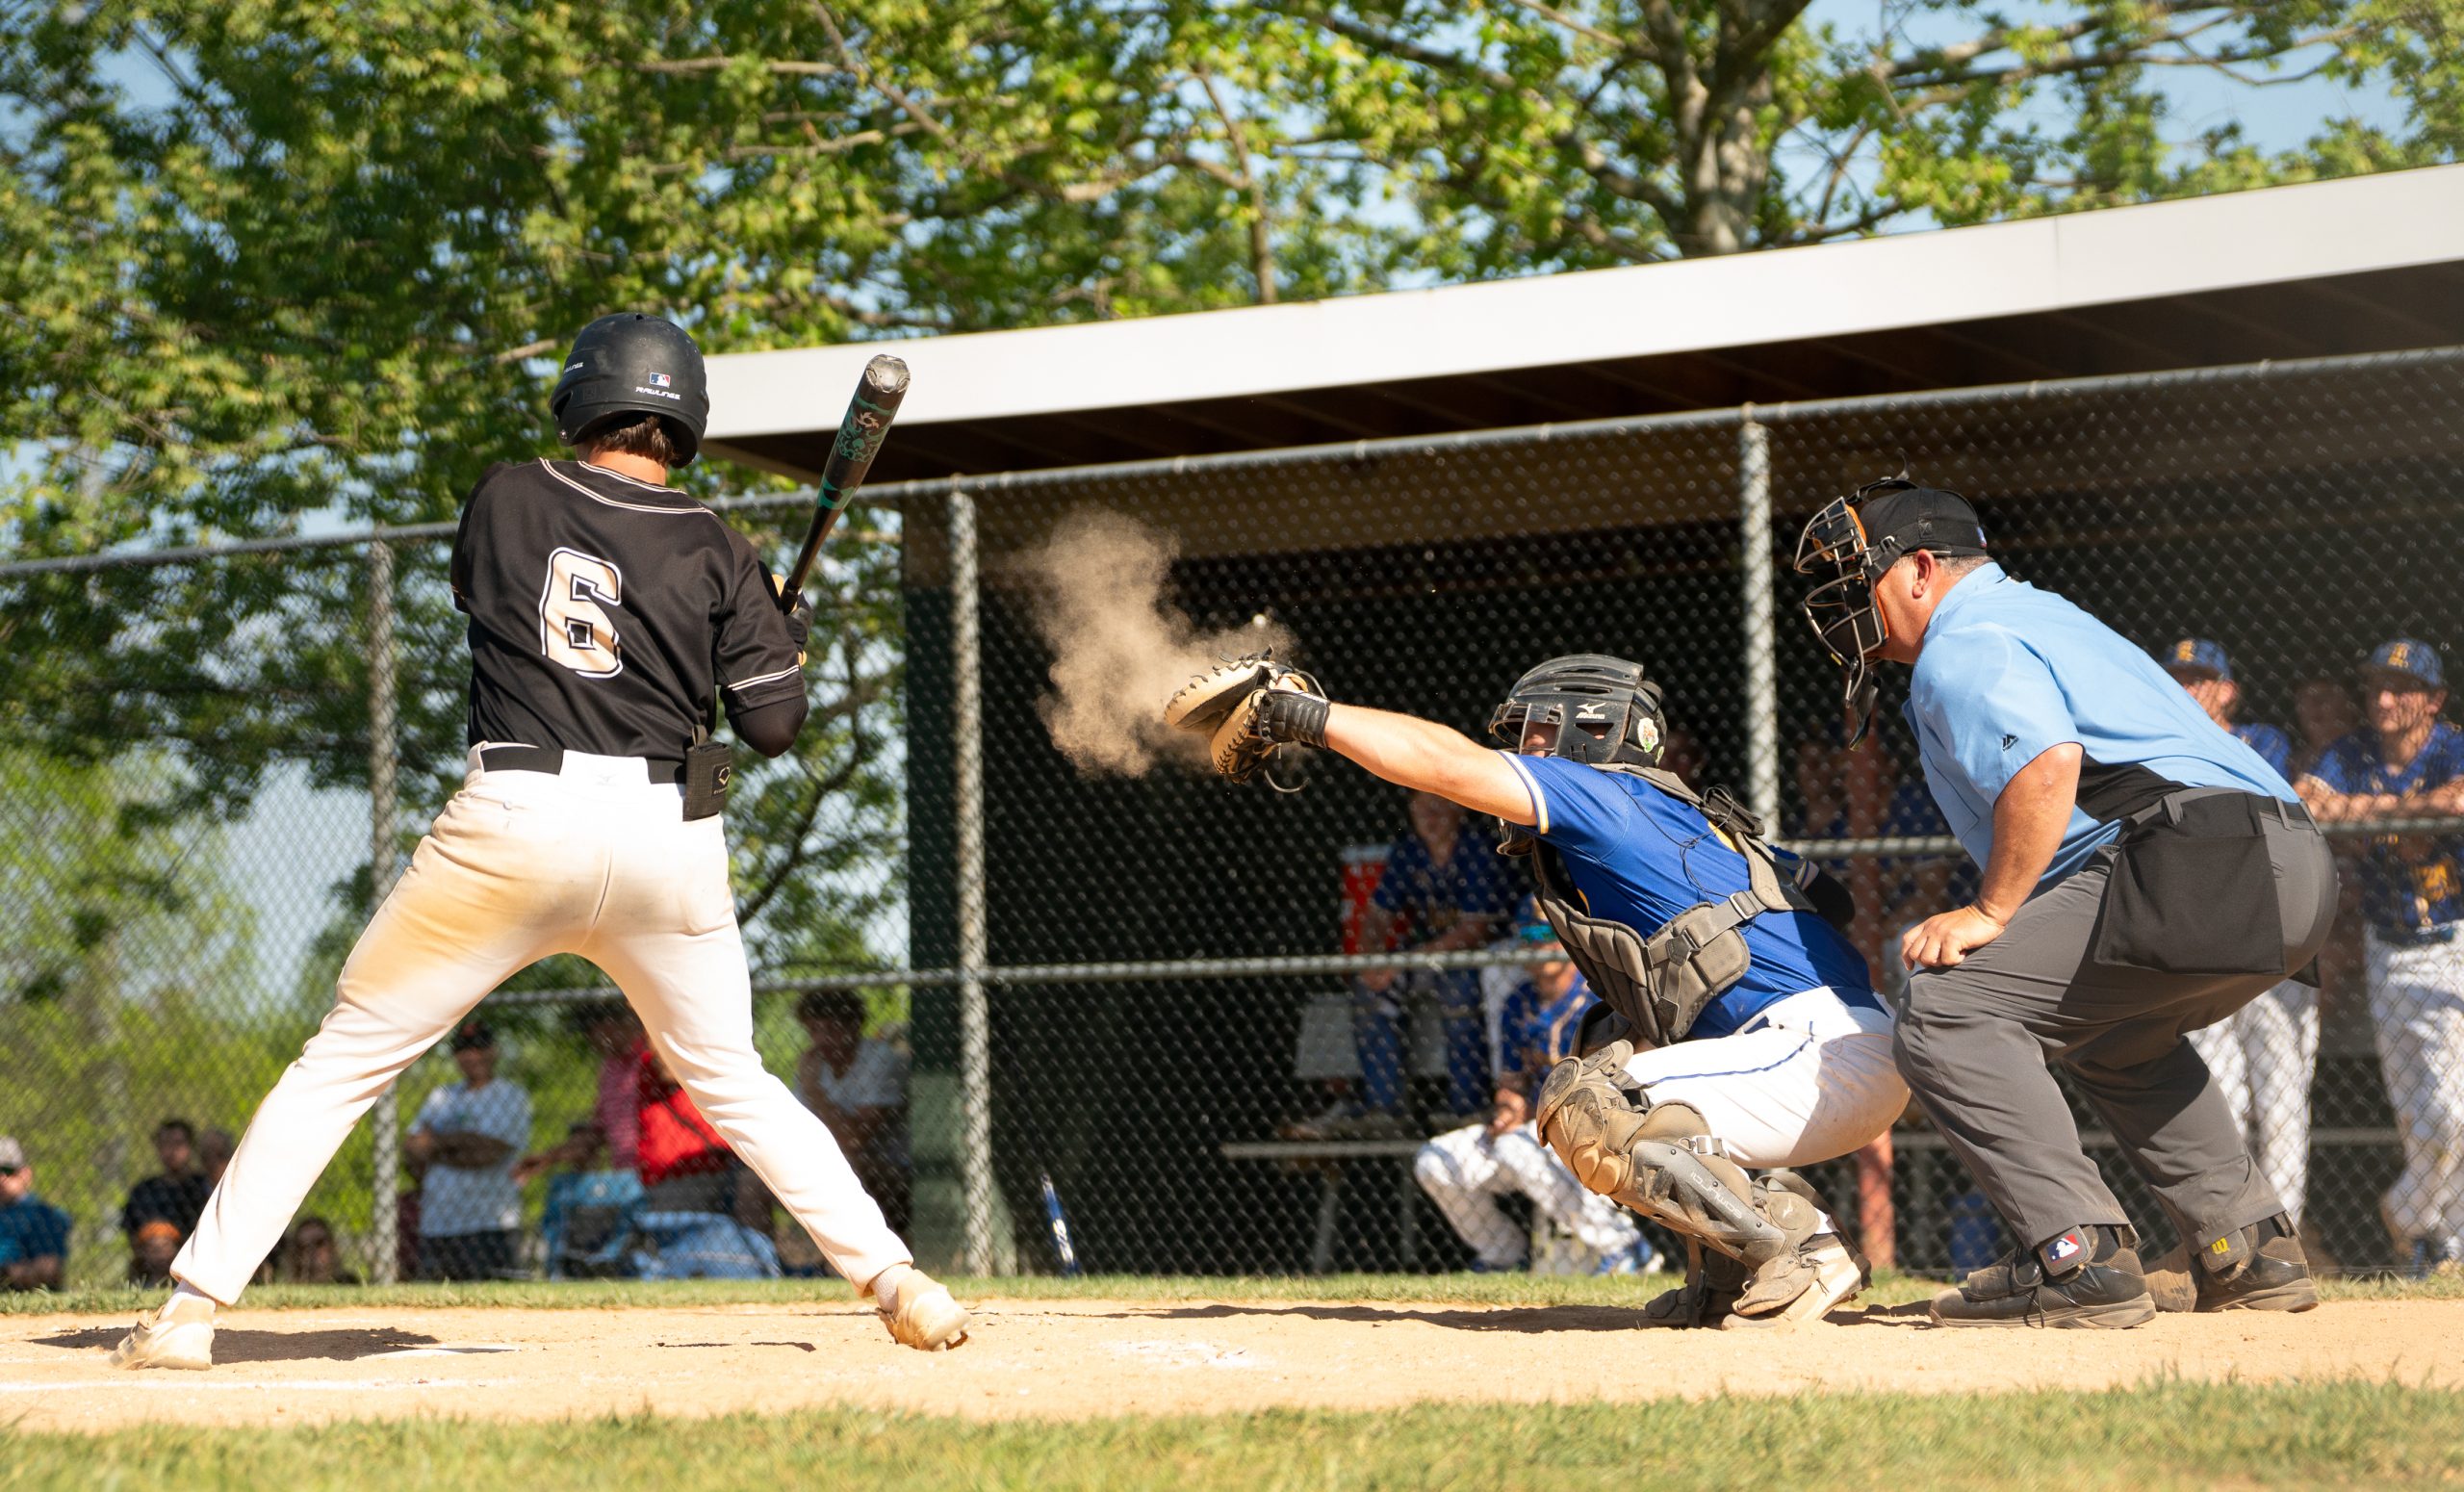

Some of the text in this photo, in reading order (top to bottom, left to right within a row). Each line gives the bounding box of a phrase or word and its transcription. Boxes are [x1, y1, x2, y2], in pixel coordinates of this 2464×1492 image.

[635, 386, 680, 399] RAWLINGS
[539, 550, 623, 679] 6
[1691, 1171, 1742, 1219] samurai
